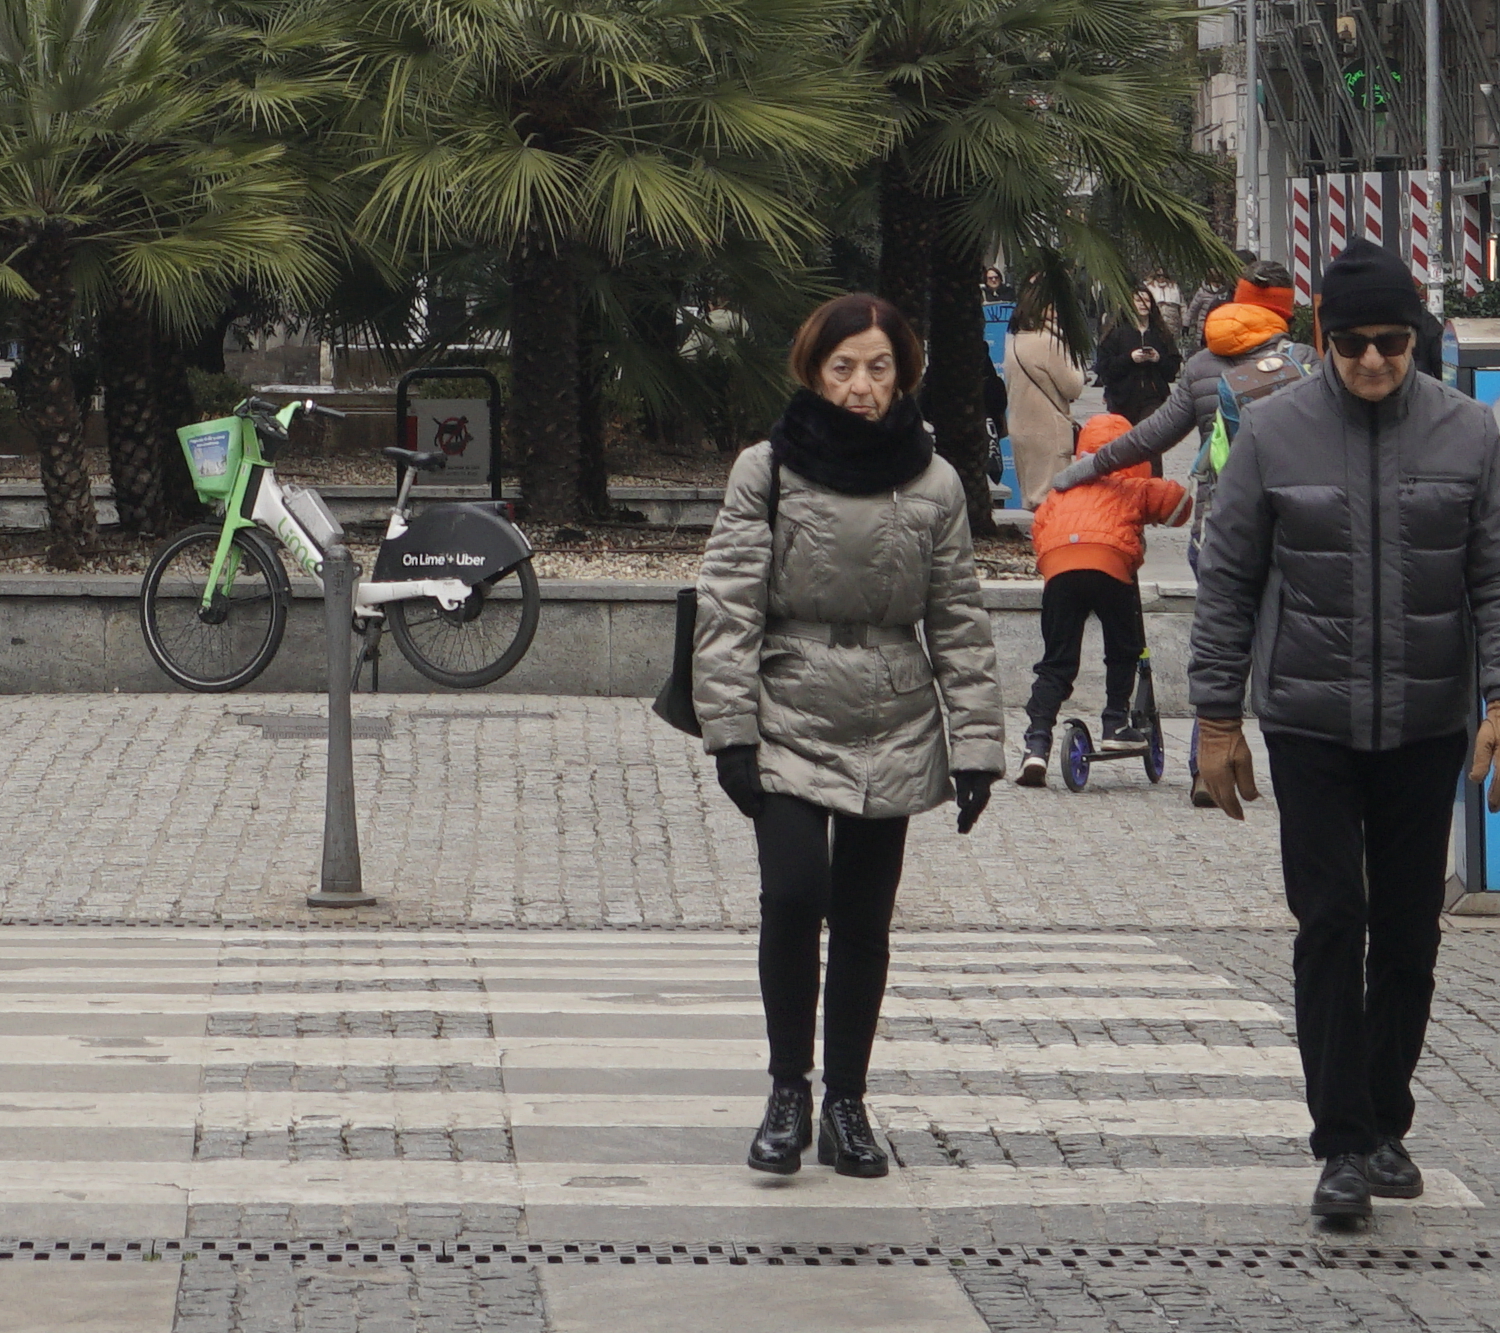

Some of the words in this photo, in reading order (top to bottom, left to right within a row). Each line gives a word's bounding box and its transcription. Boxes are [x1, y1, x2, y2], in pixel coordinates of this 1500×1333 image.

[402, 553, 418, 566] On
[419, 553, 445, 566] Lime
[455, 552, 486, 566] Uber
